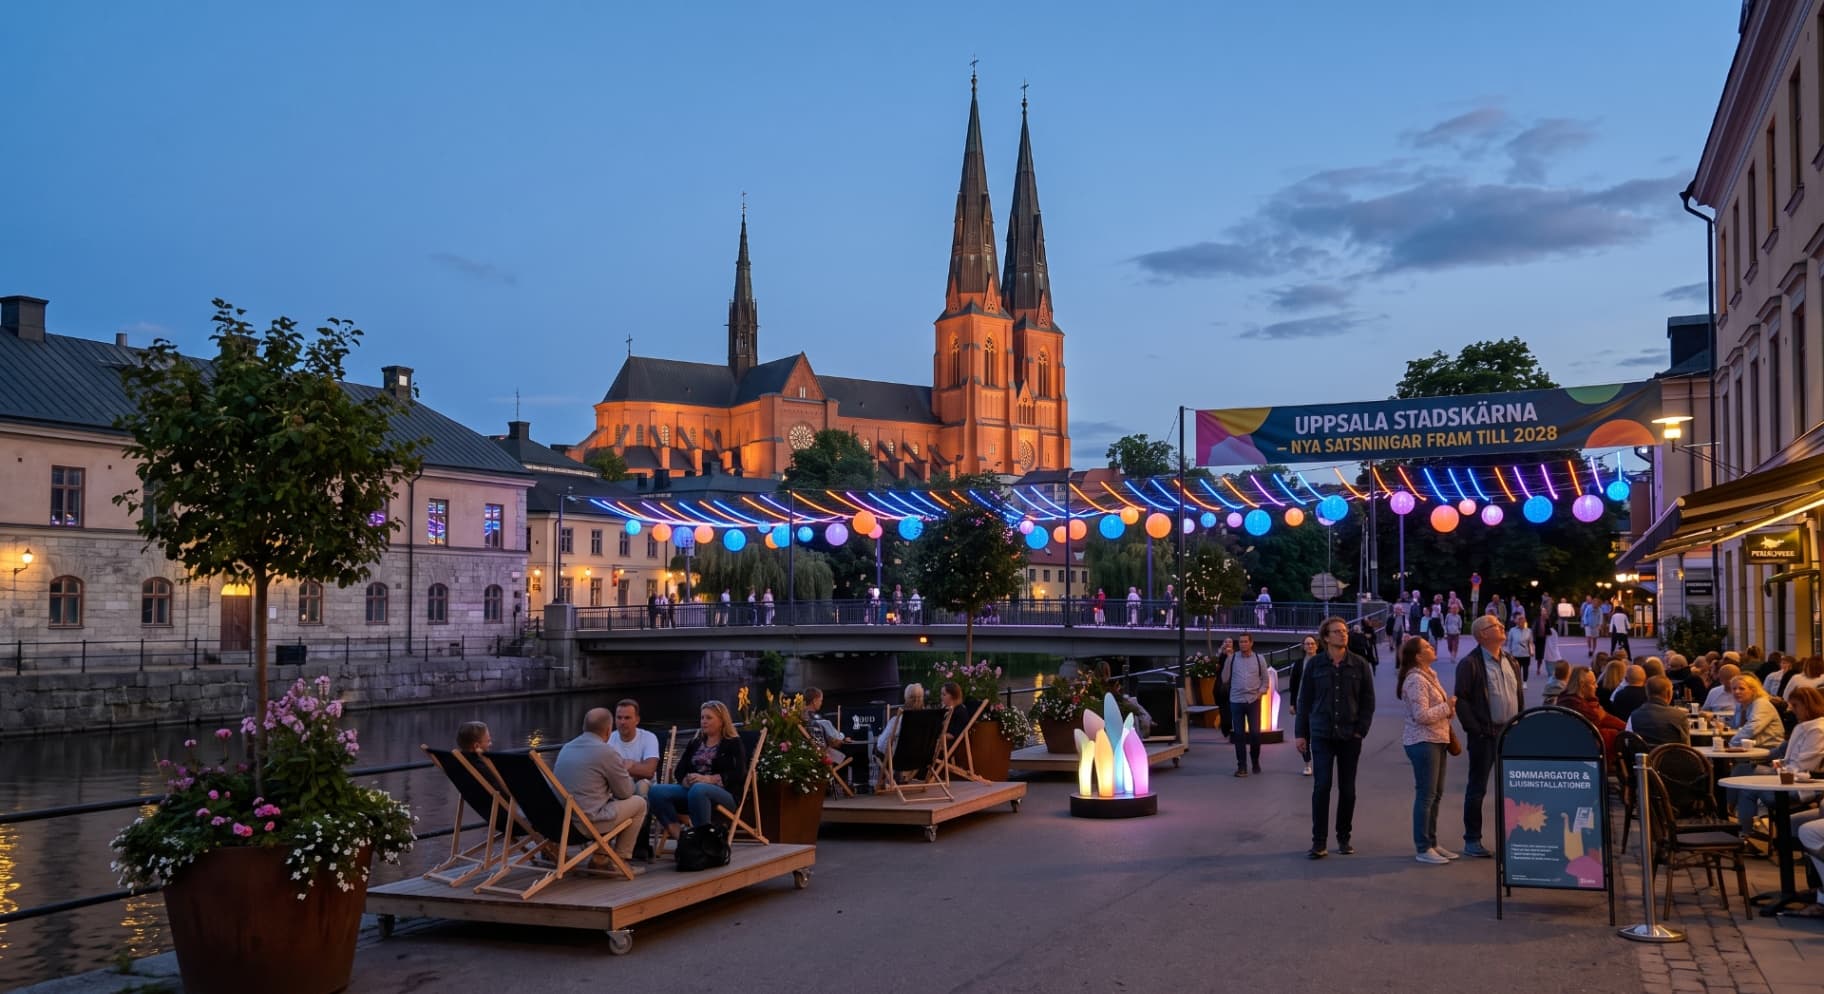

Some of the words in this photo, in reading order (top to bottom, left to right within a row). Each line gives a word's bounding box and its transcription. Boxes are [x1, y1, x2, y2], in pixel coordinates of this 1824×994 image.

[1295, 411, 1389, 435] UPPSALA
[1393, 400, 1538, 430] STADSKÄRNA
[1291, 439, 1322, 454] NYA
[1325, 433, 1422, 453] SATSNINGAR
[1426, 431, 1473, 447] FRAM
[1476, 429, 1510, 445] TILL
[1513, 425, 1558, 443] 2028
[1509, 770, 1580, 780] SOMMARGATOR
[1582, 771, 1590, 780] &
